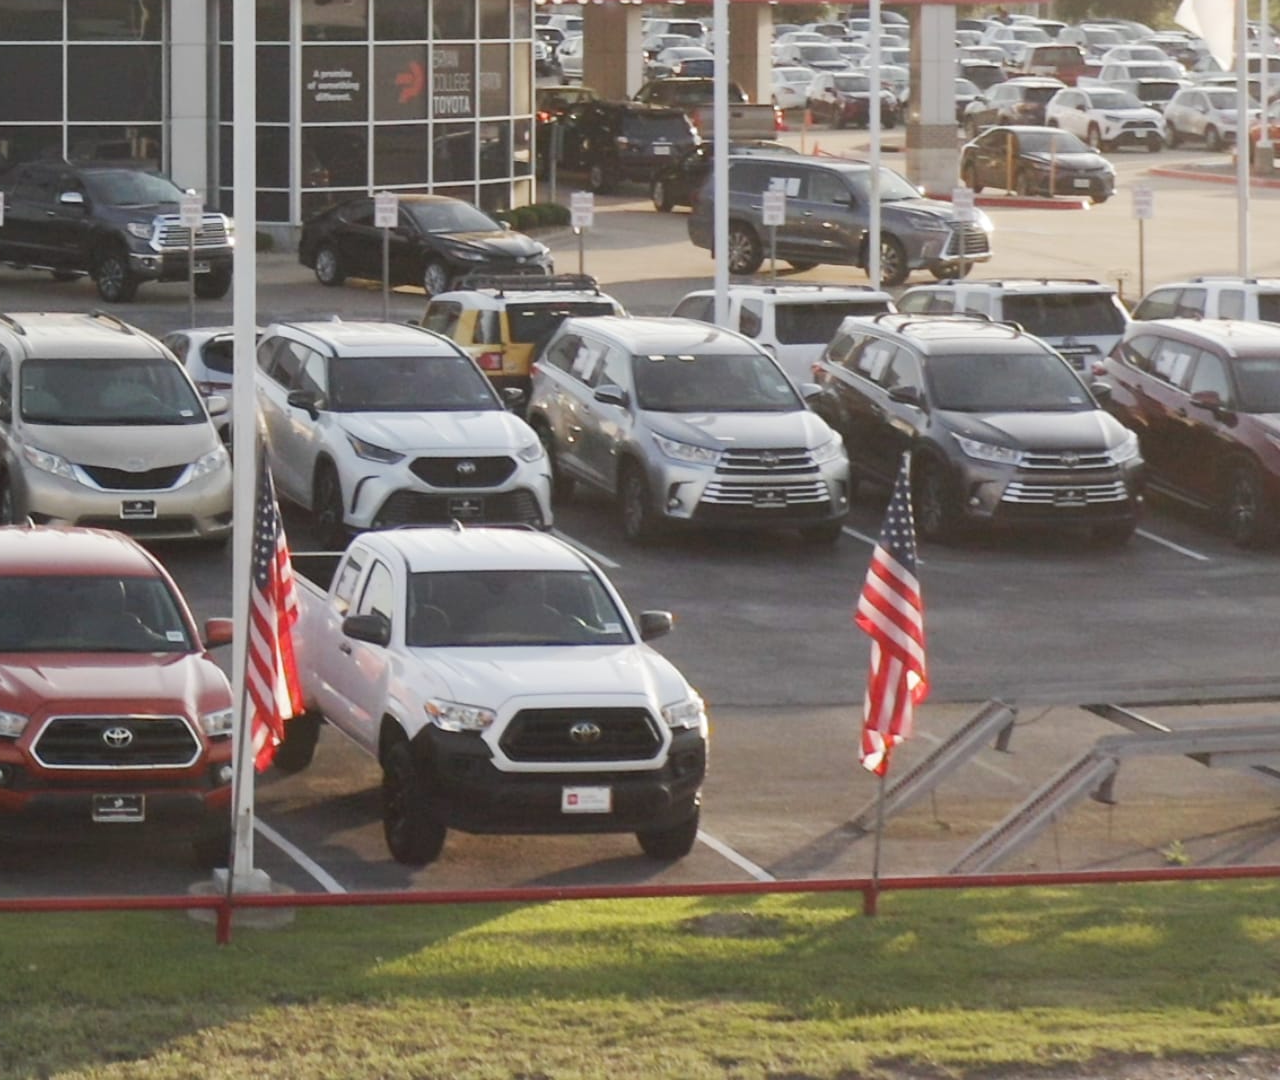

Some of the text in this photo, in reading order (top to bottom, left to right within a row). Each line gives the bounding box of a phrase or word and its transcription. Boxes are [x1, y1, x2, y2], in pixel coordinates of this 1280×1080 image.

[320, 68, 352, 80] promise
[318, 80, 360, 91] something
[433, 96, 471, 114] TOYOTA
